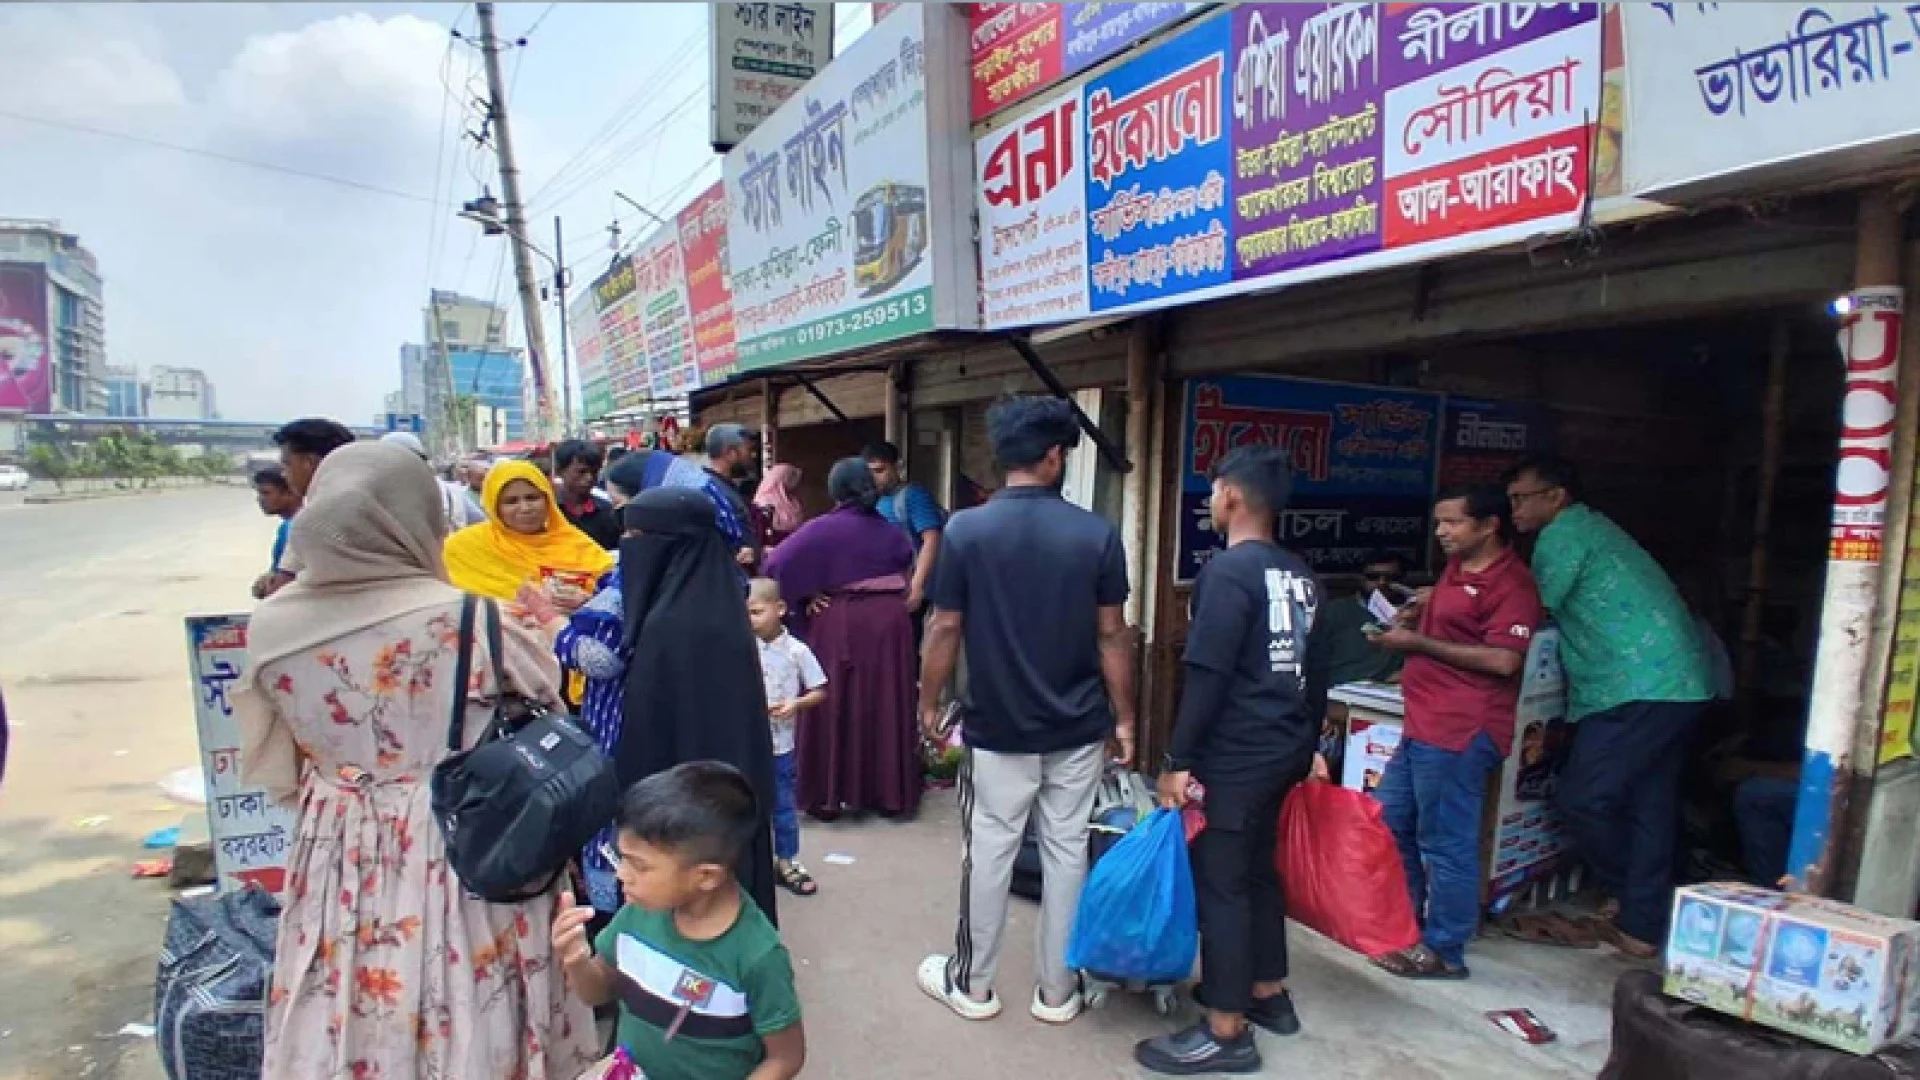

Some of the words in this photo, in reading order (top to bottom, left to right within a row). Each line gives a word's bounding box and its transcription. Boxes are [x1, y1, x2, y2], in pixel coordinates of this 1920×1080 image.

[1397, 2, 1581, 66] নীলাচ
[1694, 4, 1920, 117] ভান্ডারিয়া-
[983, 98, 1078, 208] এনা
[1088, 86, 1226, 190] ইকোনো
[1404, 56, 1582, 155] সৌদিয়া
[738, 149, 782, 233] স্টার
[783, 96, 849, 217] লাইন
